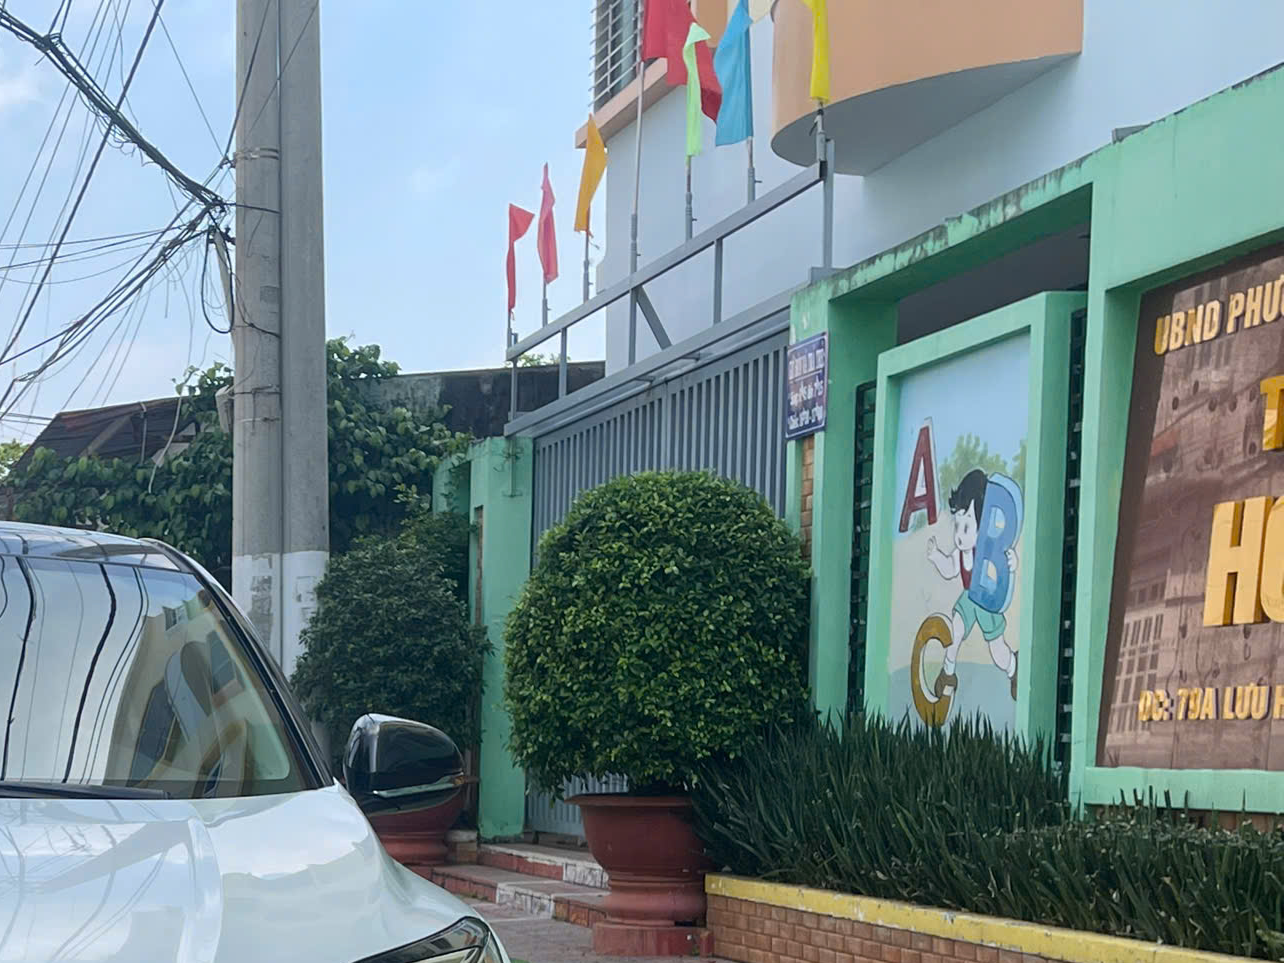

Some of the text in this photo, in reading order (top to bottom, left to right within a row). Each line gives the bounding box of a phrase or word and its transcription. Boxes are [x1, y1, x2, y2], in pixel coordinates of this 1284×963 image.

[1154, 274, 1284, 356] UBND PHƯ
[899, 421, 939, 533] A
[968, 473, 1023, 614] B
[1177, 687, 1216, 720] 79A
